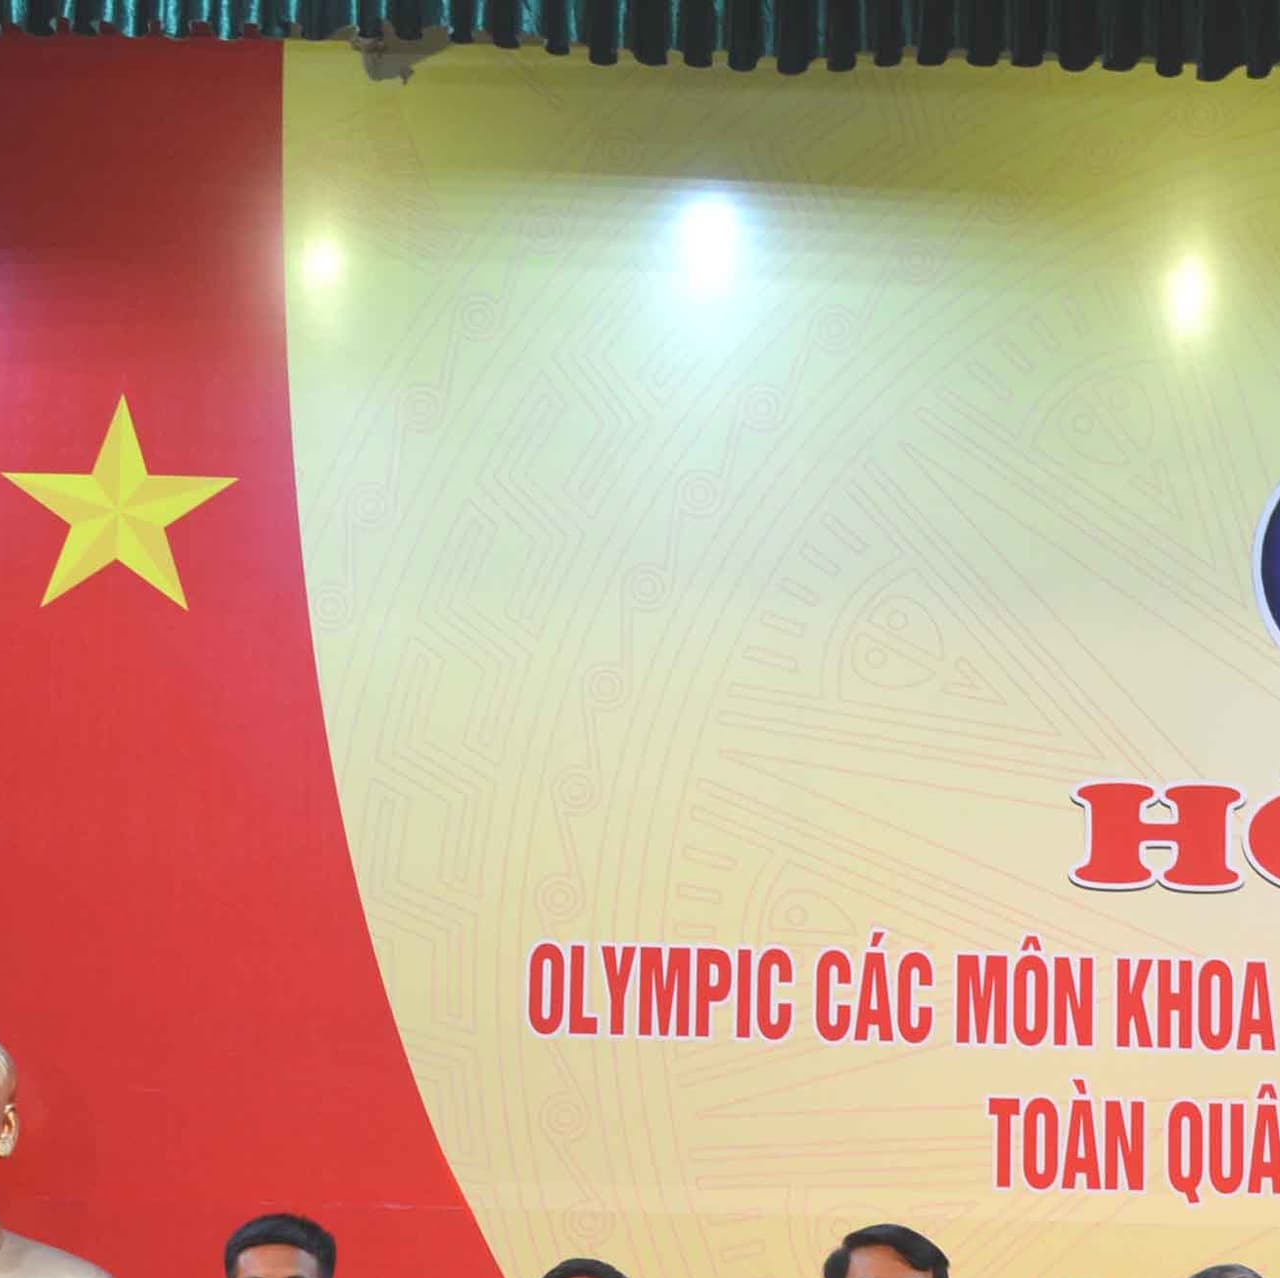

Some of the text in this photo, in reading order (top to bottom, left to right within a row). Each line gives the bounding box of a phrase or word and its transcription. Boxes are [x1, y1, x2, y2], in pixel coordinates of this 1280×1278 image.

[528, 942, 794, 1041] OLYMPIC
[815, 931, 934, 1044] CÁC
[956, 935, 1095, 1048] MÔN
[1115, 957, 1277, 1052] KHOA
[987, 1077, 1146, 1192] TOÀN
